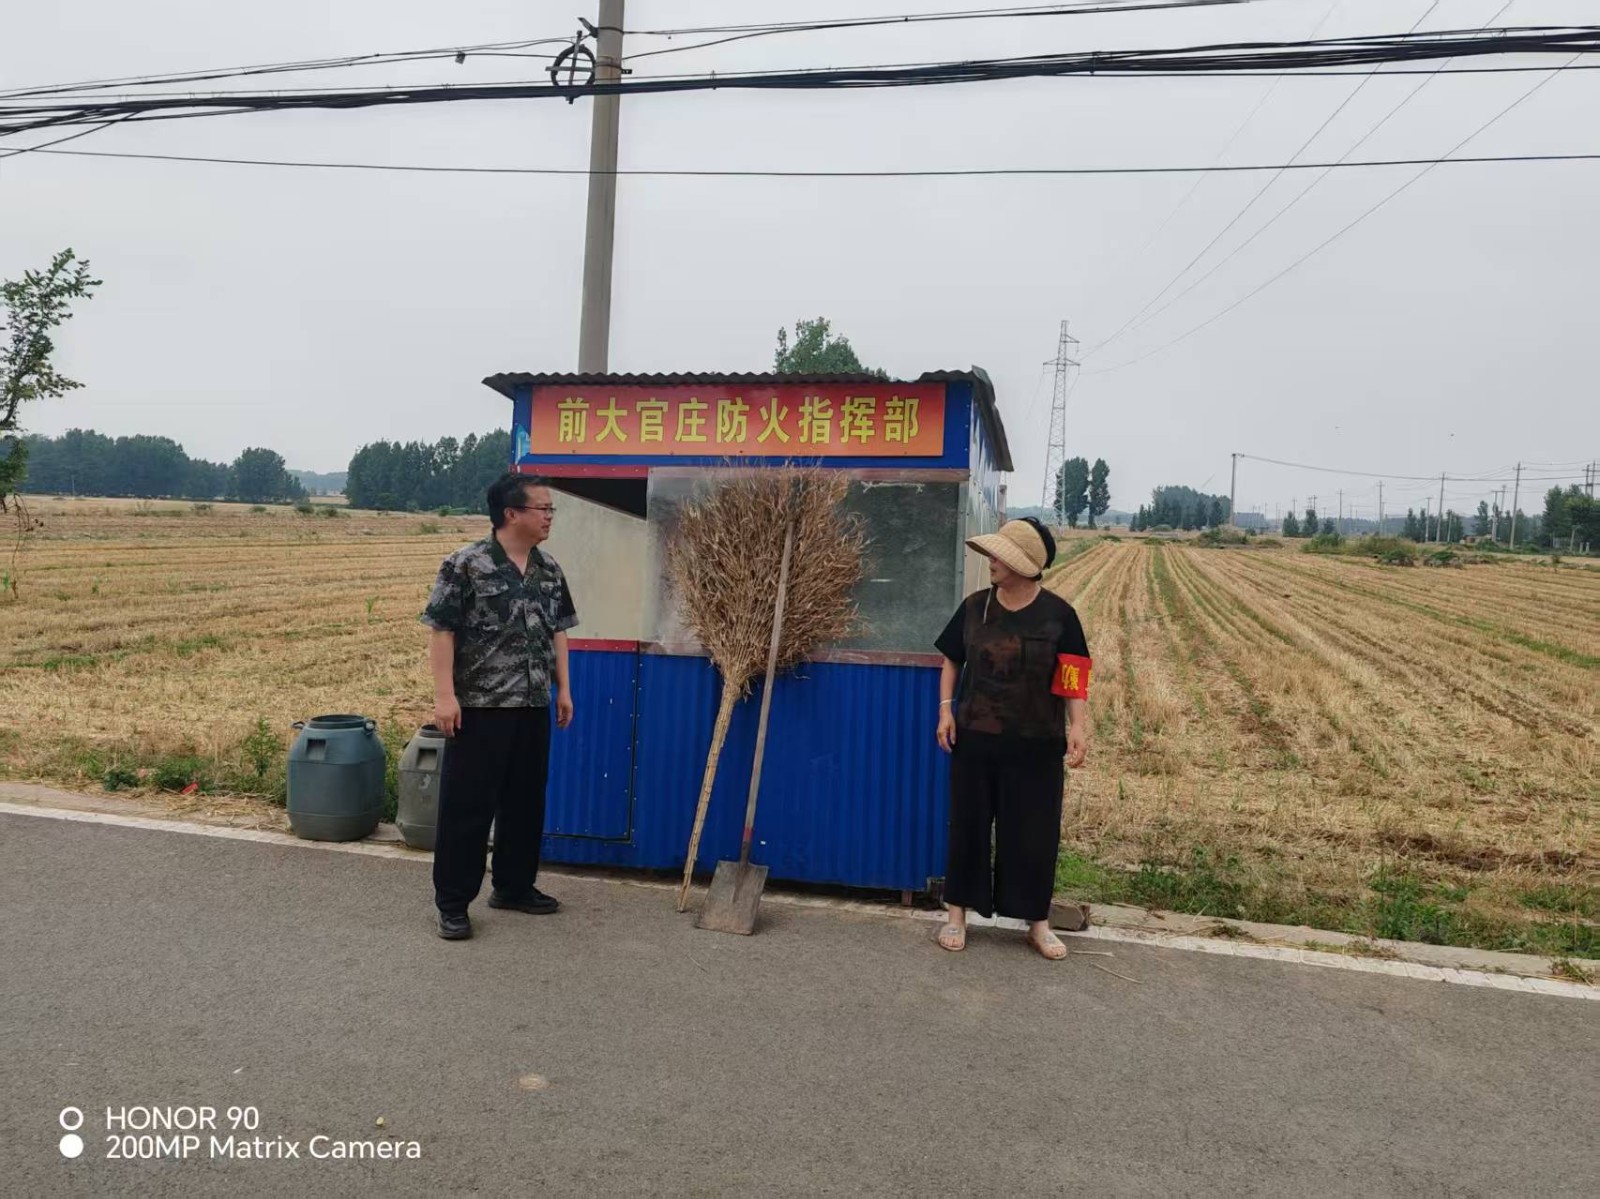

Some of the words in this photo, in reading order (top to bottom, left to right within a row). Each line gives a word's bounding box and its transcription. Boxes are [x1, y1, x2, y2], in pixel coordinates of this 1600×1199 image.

[557, 396, 920, 445] 前大官庄防火指挥部
